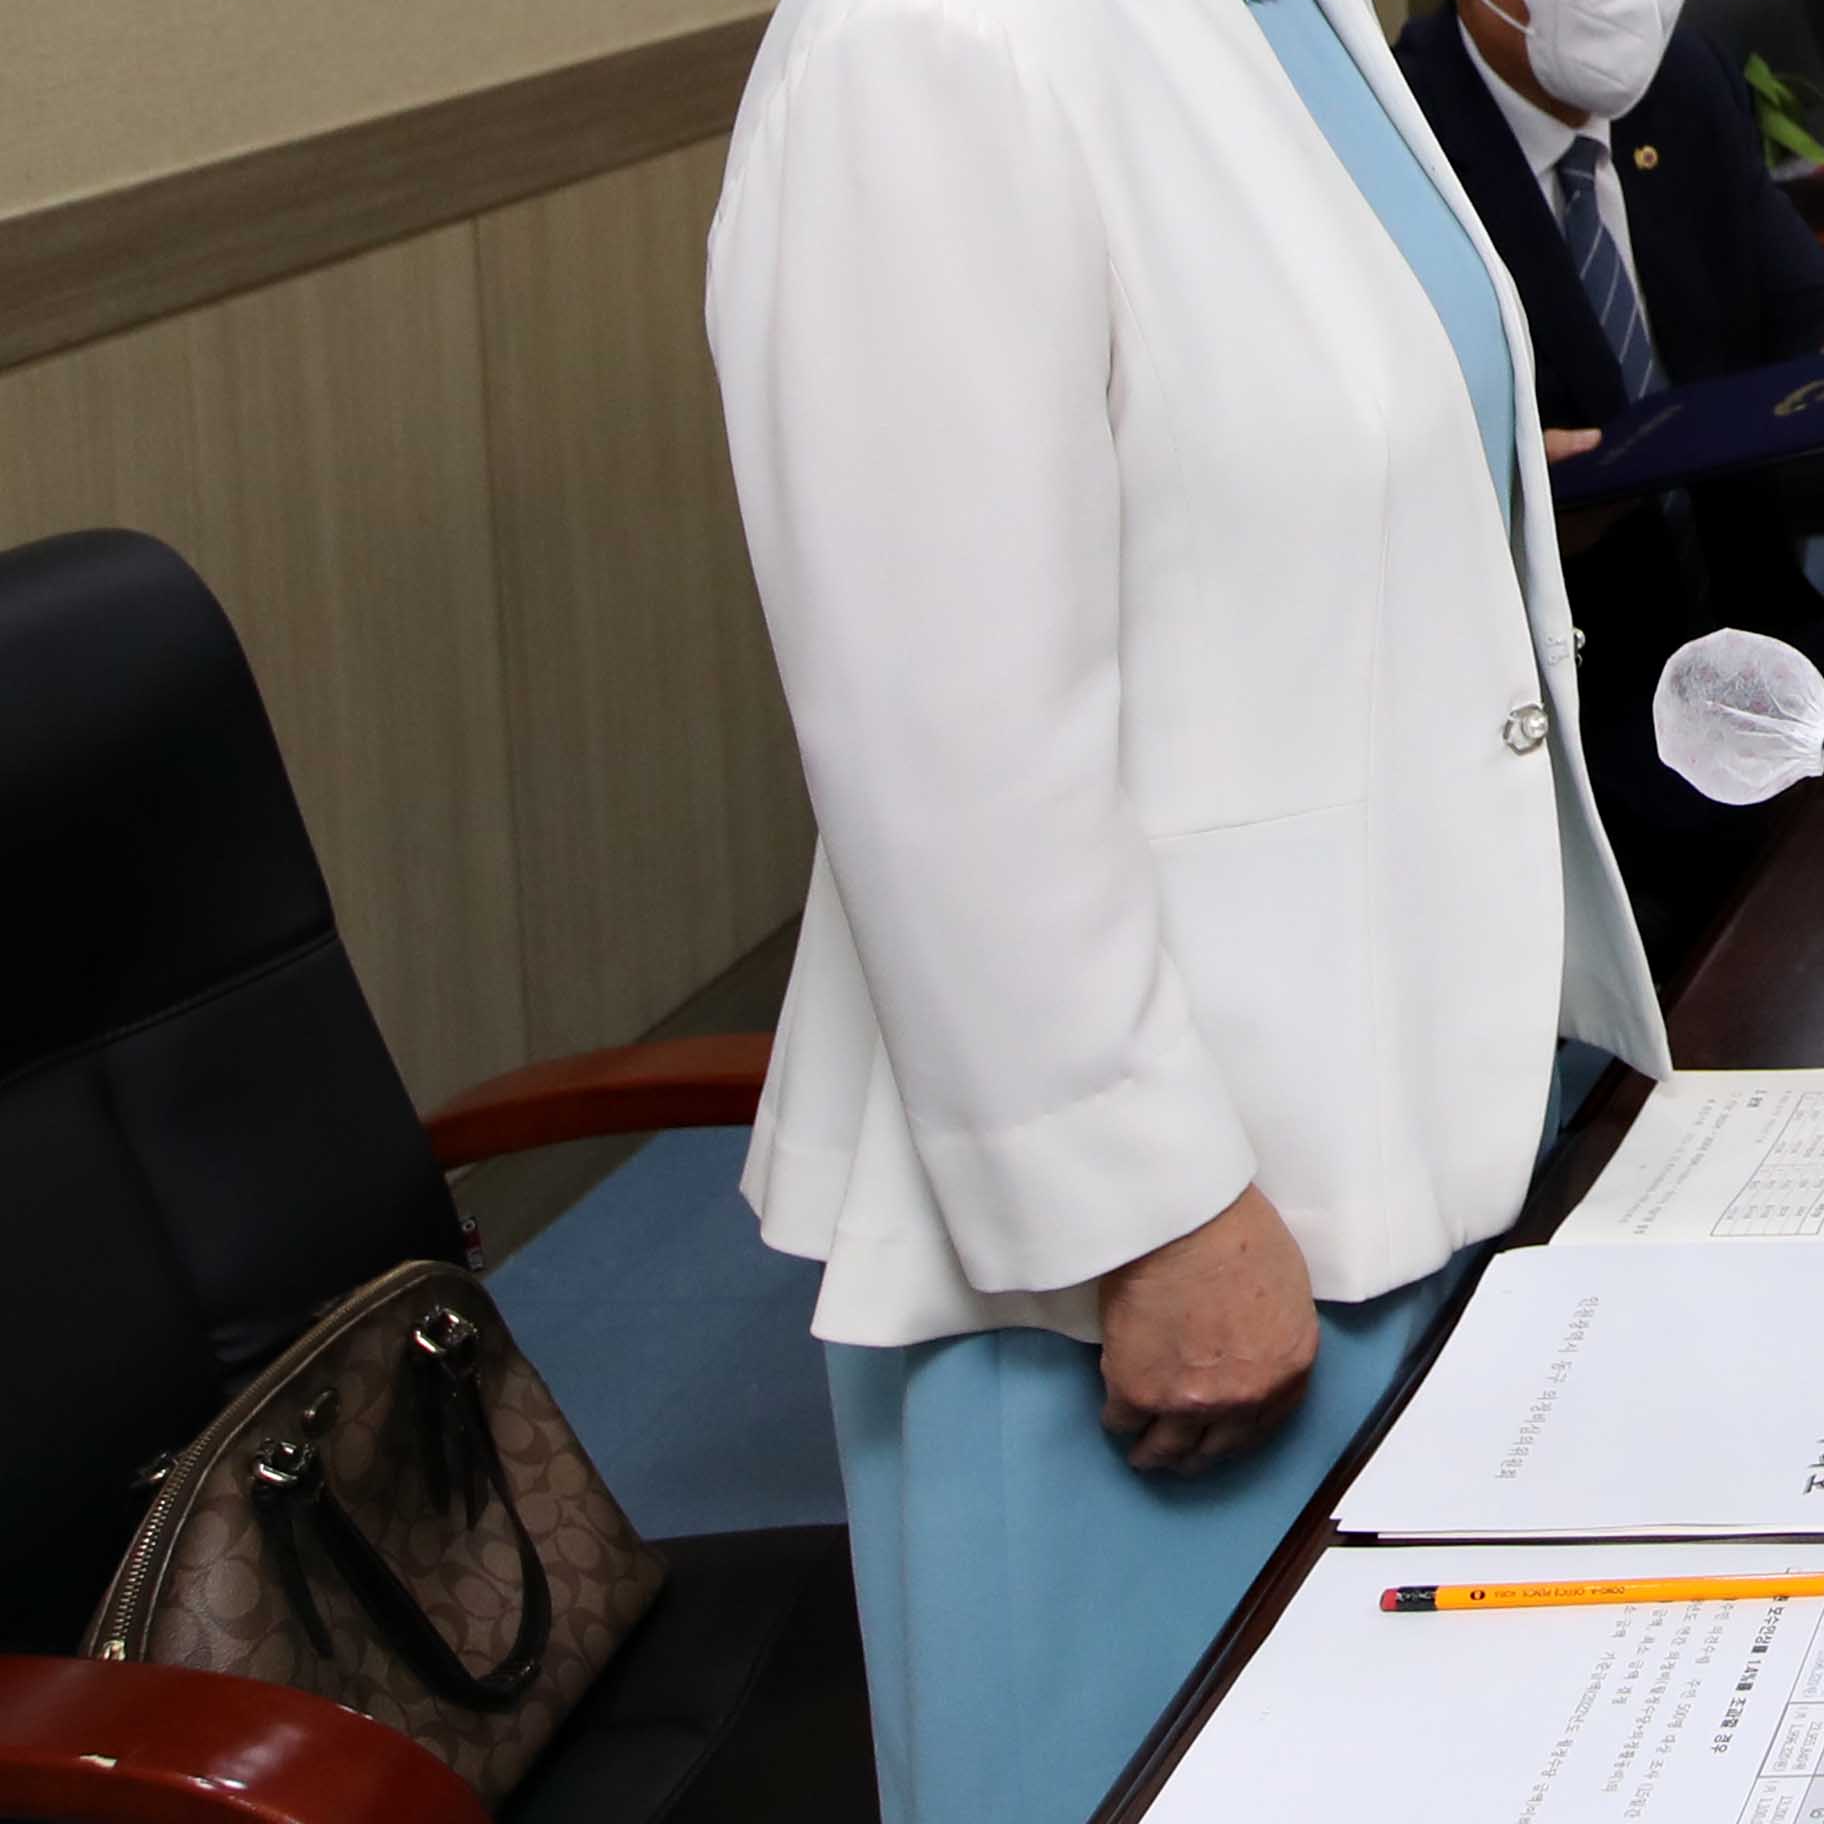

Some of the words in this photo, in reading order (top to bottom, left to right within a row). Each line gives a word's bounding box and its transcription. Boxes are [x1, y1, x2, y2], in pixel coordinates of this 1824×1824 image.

[1557, 1296, 1601, 1354] 인천광역시
[1547, 1360, 1574, 1384] 동구
[1751, 1607, 1785, 1654] 보수인상률
[1719, 1697, 1748, 1729] 초과할
[1710, 1733, 1734, 1754] 경우
